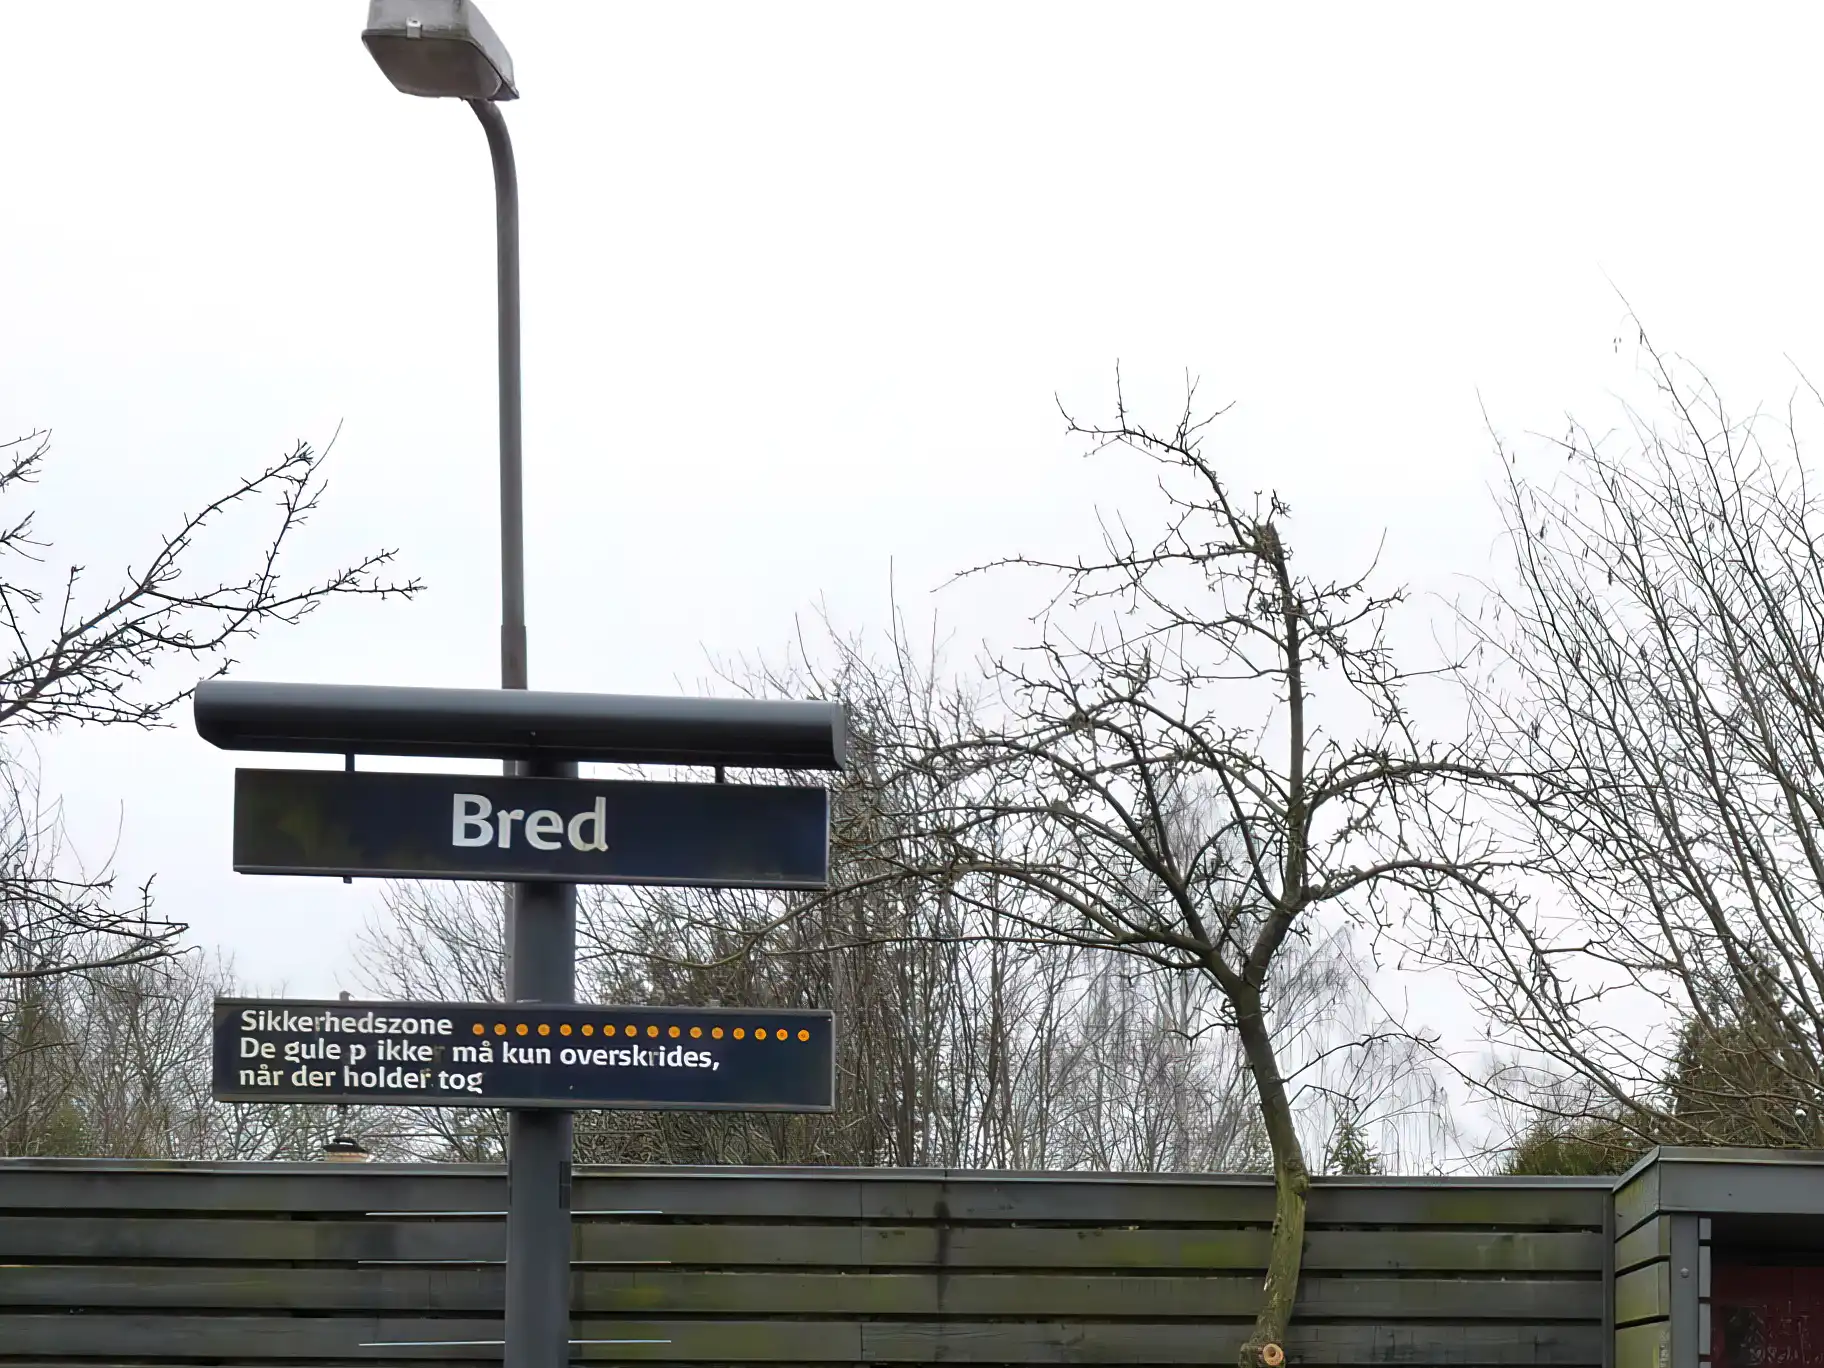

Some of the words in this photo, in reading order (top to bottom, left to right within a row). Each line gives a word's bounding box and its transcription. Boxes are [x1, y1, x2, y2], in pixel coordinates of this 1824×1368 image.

[452, 792, 609, 852] Bred
[240, 1009, 454, 1037] Sikkerhedszone
[240, 1037, 276, 1060] De
[283, 1038, 342, 1064] gule
[452, 1040, 494, 1064] må
[502, 1042, 552, 1065] kun
[560, 1045, 720, 1071] overskrides,
[239, 1063, 285, 1086] når
[292, 1065, 337, 1088] der
[344, 1065, 432, 1090] holder
[439, 1070, 485, 1094] tog
